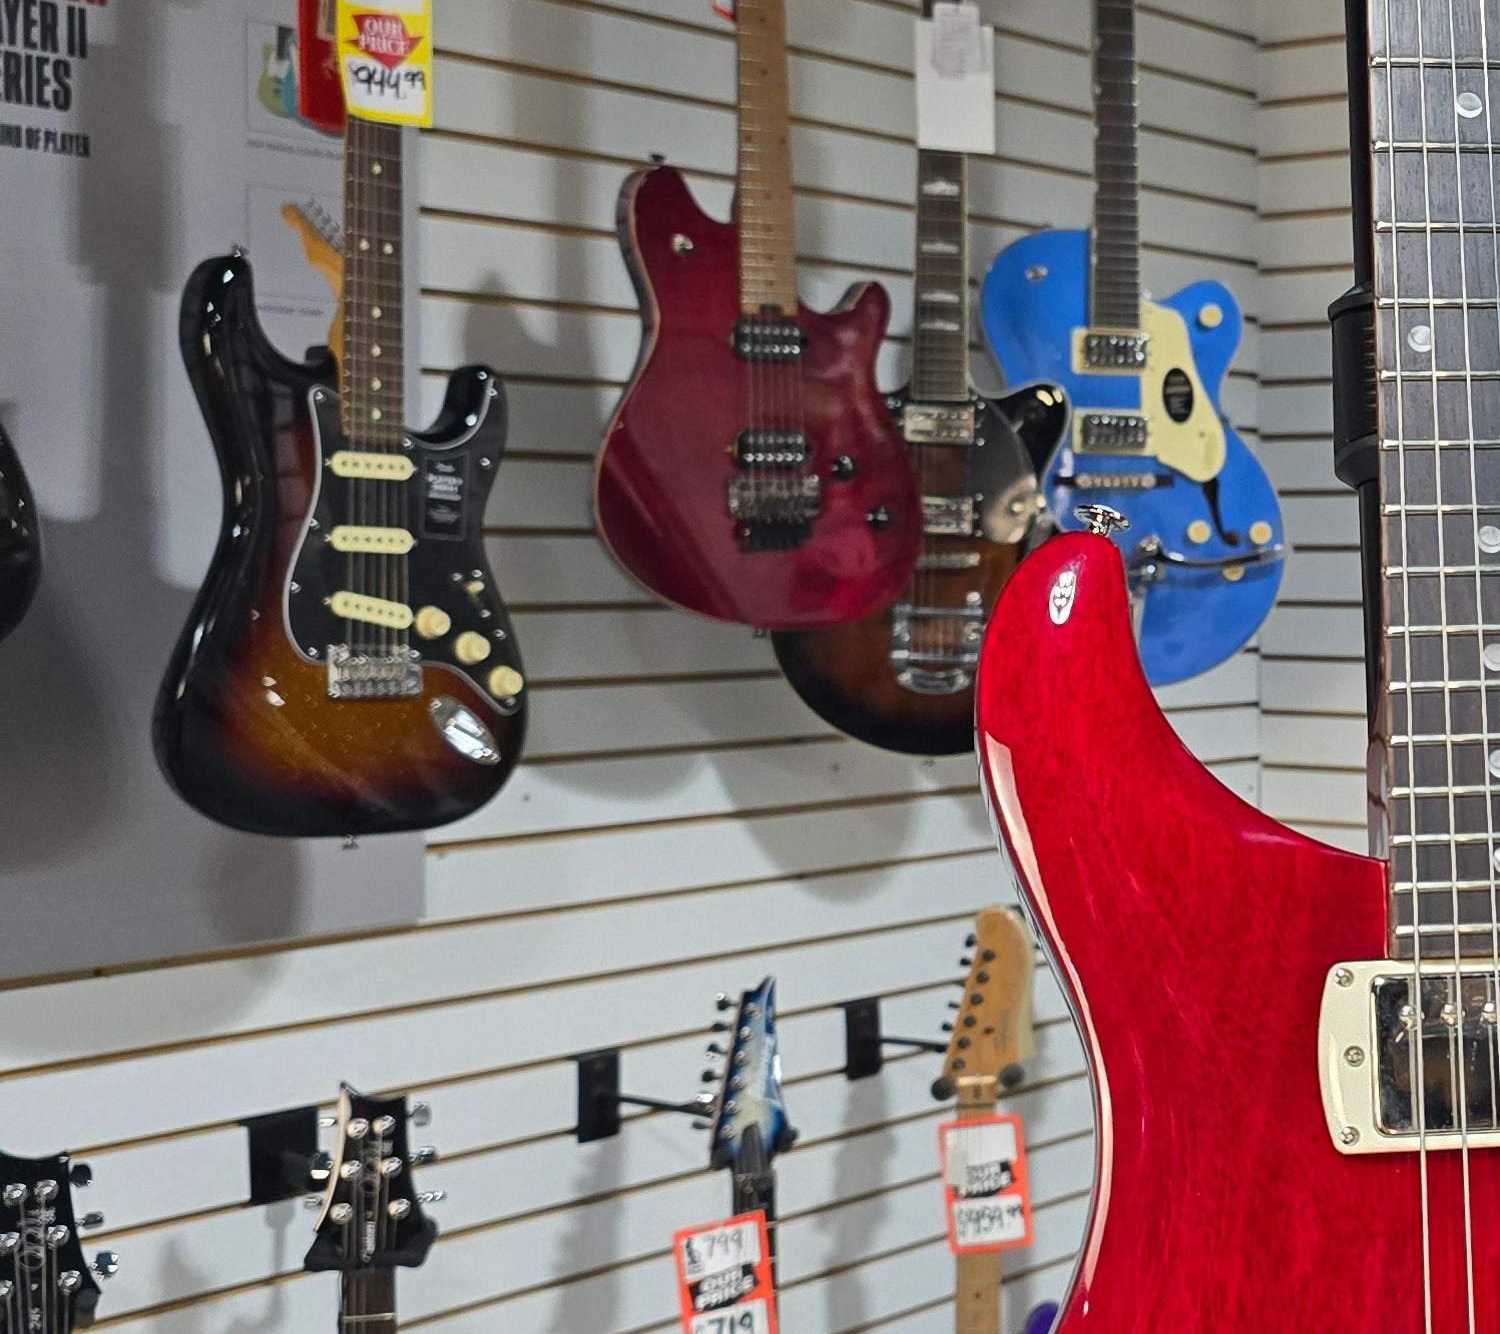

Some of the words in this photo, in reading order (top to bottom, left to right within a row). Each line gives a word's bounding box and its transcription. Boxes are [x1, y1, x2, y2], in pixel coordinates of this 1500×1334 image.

[67, 4, 87, 60] II
[363, 17, 402, 36] OUR
[358, 33, 409, 56] PRICE
[0, 51, 72, 112] RIES
[694, 1275, 755, 1310] PRICE
[699, 1269, 743, 1293] OUR
